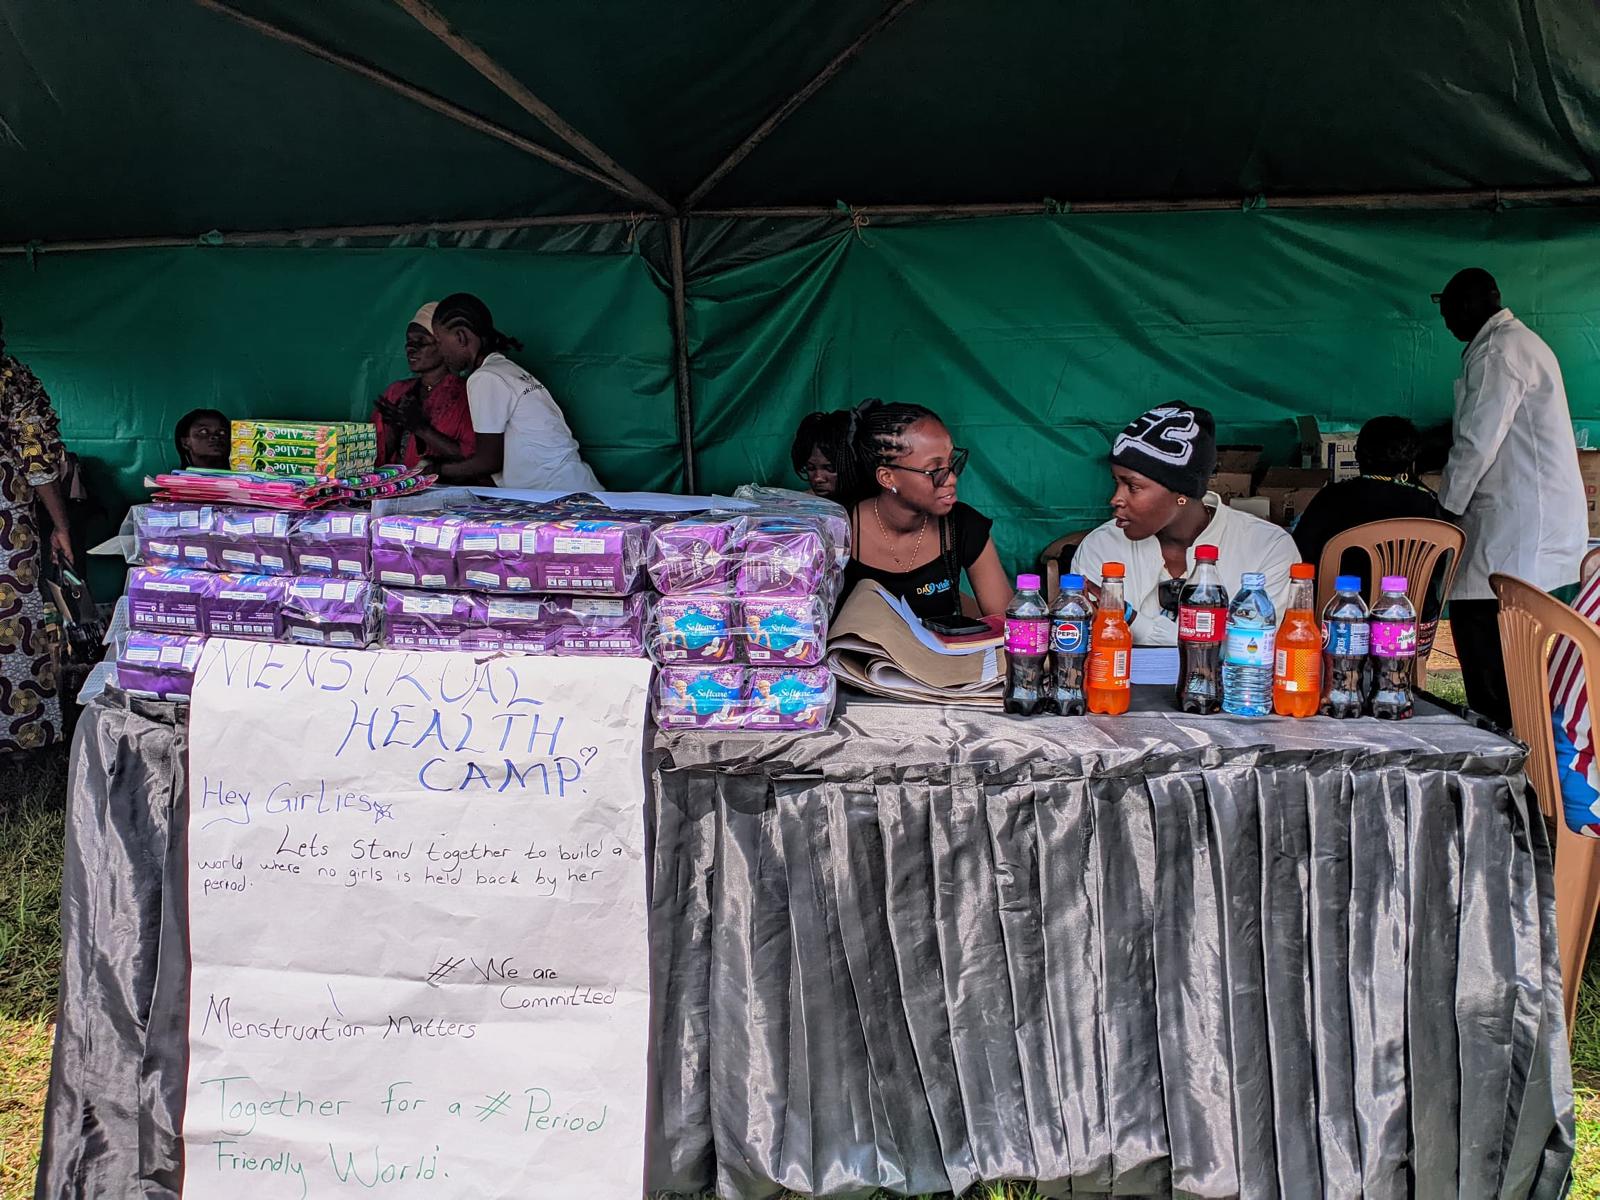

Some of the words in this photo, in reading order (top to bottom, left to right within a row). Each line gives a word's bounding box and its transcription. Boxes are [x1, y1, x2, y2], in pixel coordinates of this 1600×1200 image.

[274, 462, 298, 474] Aloe
[275, 445, 299, 455] Aloe
[197, 640, 544, 707] MENSTRUAL
[696, 688, 728, 699] Softcare
[336, 699, 565, 756] HEALTH
[201, 776, 252, 826] Hey
[276, 824, 330, 858] Lets
[427, 839, 511, 872] together
[524, 840, 547, 860] to
[559, 837, 603, 860] build
[612, 846, 624, 858] a
[197, 854, 243, 870] world
[318, 867, 337, 878] no
[344, 866, 383, 888] girls
[396, 866, 412, 883] is
[424, 865, 461, 885] held
[475, 867, 519, 885] back
[534, 866, 557, 897] by
[566, 864, 601, 883] her
[470, 956, 519, 982] We
[533, 967, 557, 980] are
[201, 991, 366, 1041] Menstruation
[382, 1015, 478, 1040] Matters
[499, 985, 617, 1010] Committed
[200, 1076, 353, 1137] Together
[447, 1102, 462, 1117] a
[524, 1086, 608, 1132] Period
[212, 1140, 307, 1199] Friendly
